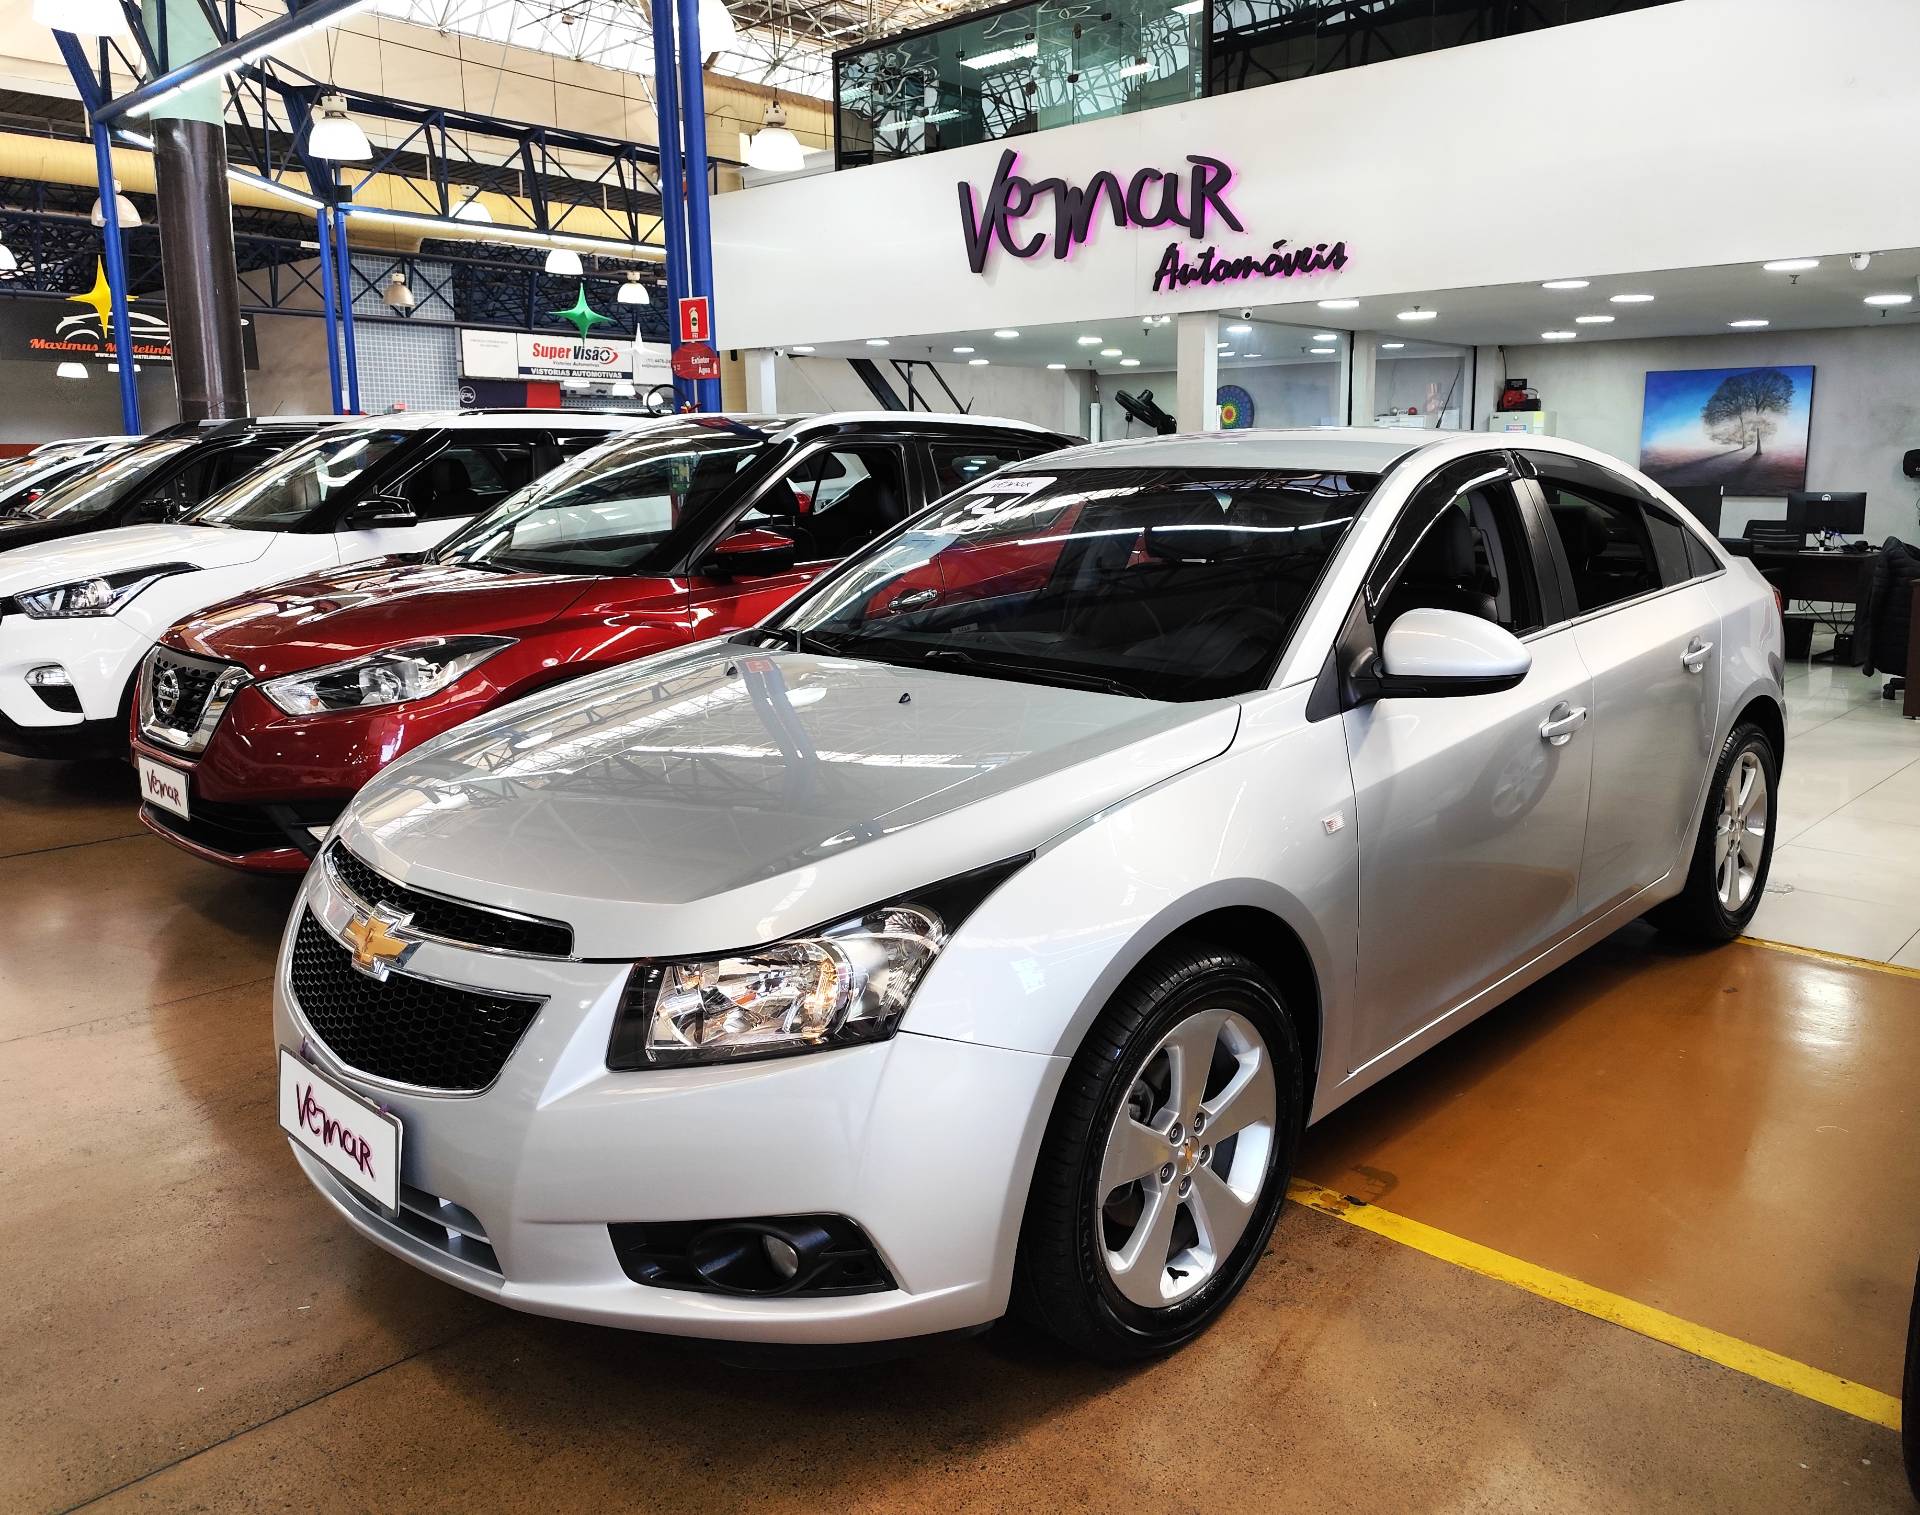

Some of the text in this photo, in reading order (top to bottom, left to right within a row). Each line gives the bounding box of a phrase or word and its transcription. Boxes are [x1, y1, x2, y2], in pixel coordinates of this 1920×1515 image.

[1152, 239, 1349, 292] Automóveis
[29, 338, 171, 355] Maximus Mtelinh
[532, 342, 572, 360] Super
[530, 367, 623, 379] VISTORIAS AUTOMOTIVAS
